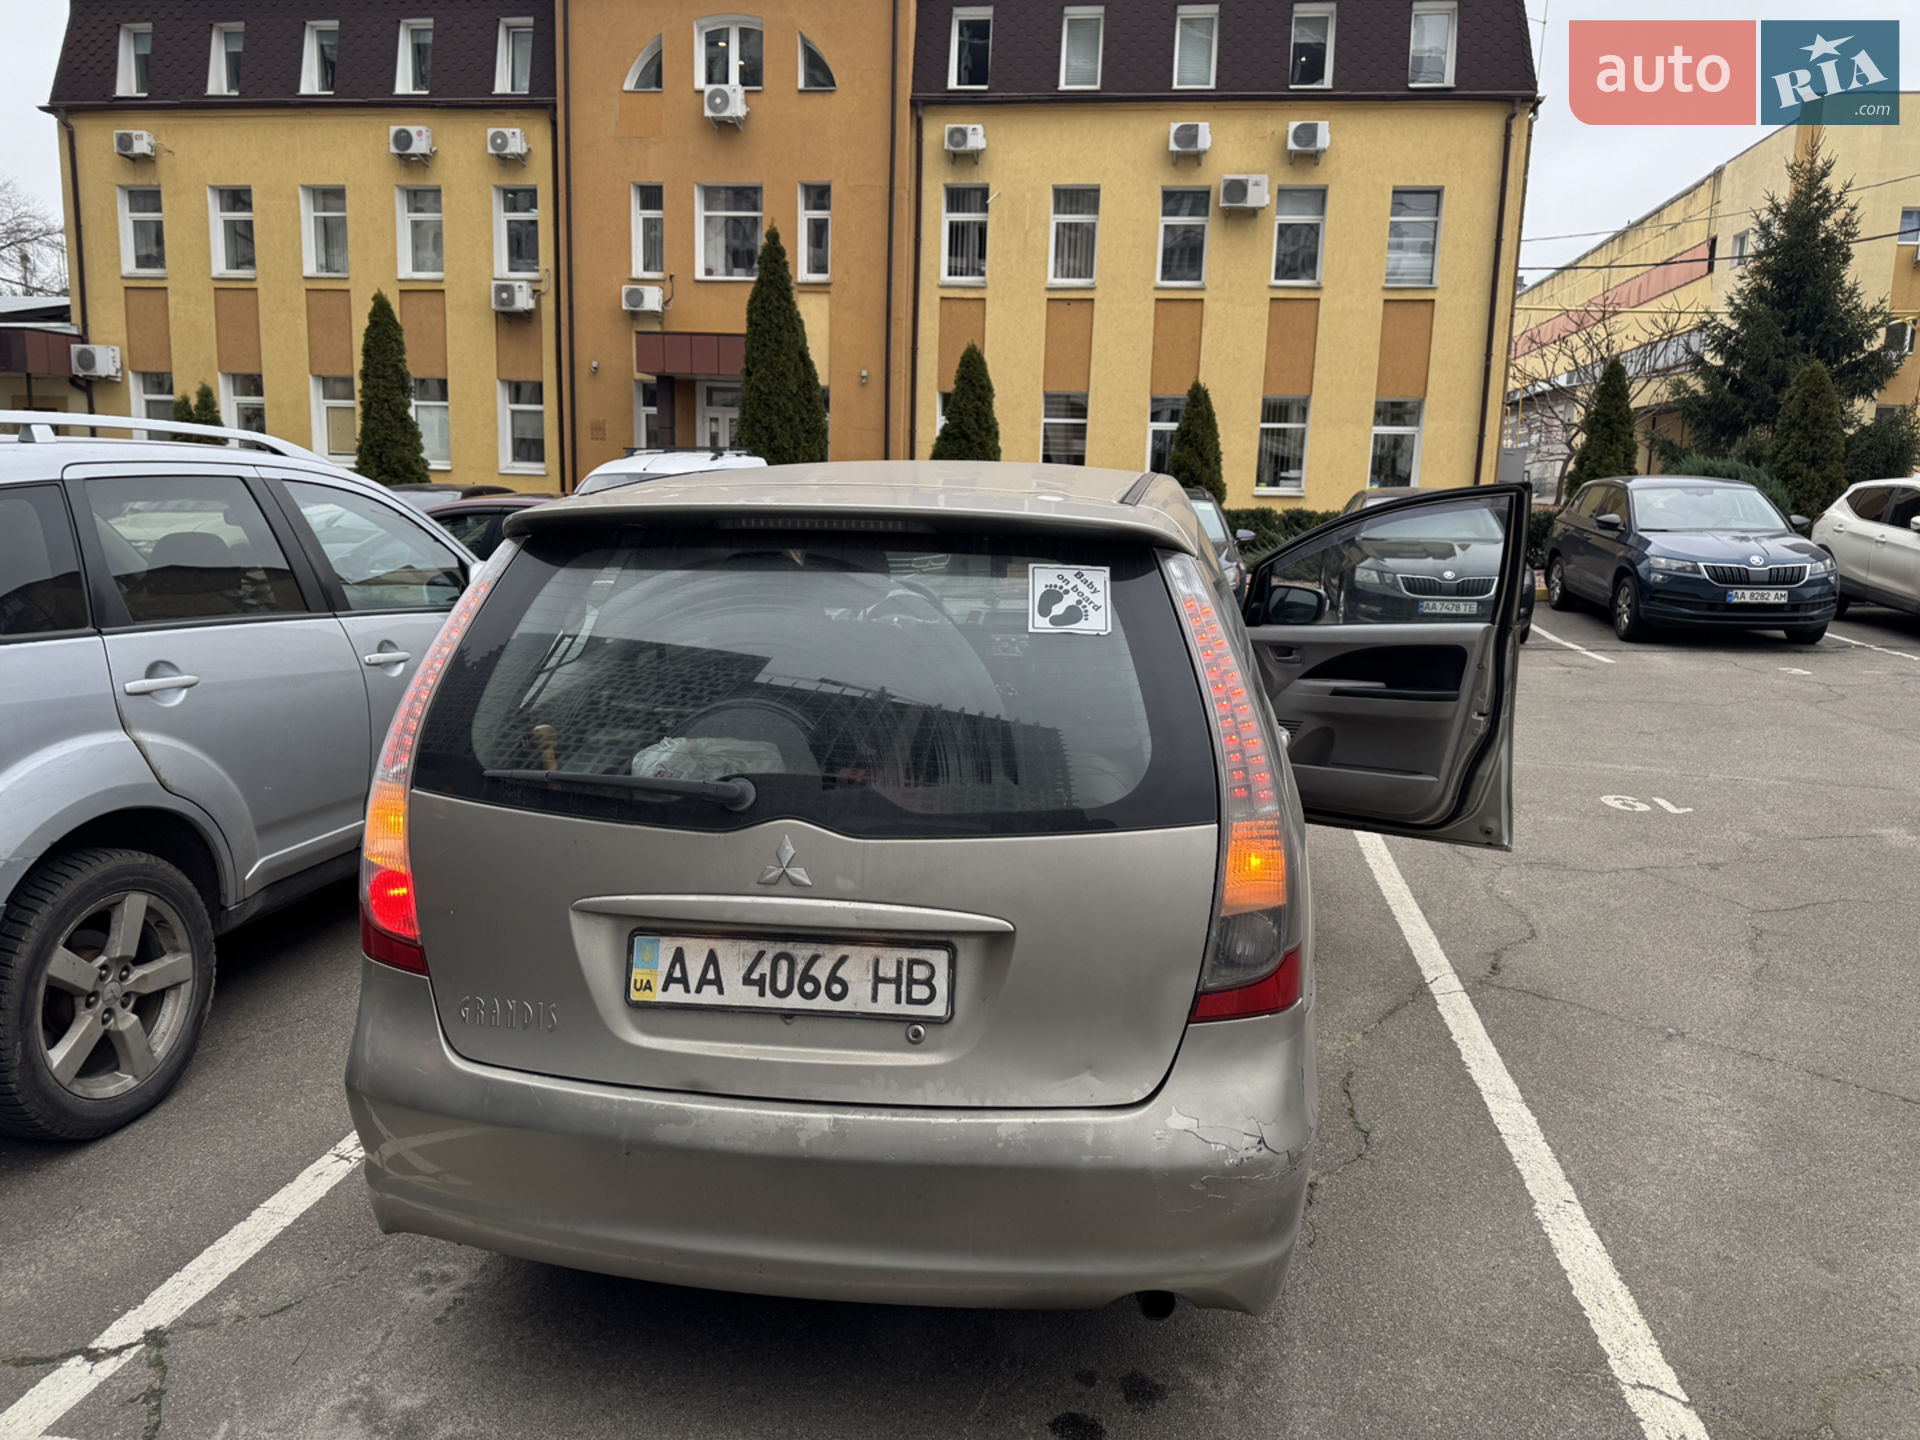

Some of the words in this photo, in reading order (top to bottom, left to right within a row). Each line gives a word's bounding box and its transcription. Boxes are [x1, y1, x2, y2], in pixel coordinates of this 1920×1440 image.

[1056, 573, 1070, 586] on
[1070, 584, 1102, 611] board
[1074, 570, 1101, 594] Baby
[1424, 602, 1437, 611] AA
[1439, 602, 1461, 612] 7478
[1462, 603, 1476, 613] TE
[1733, 591, 1746, 601] AA
[1749, 591, 1771, 601] 8282
[1773, 592, 1787, 601] AM
[633, 978, 653, 993] UA
[661, 946, 725, 995] AA
[742, 950, 849, 1002] 4066
[871, 957, 937, 1005] HB
[460, 995, 557, 1031] GRANDIS
